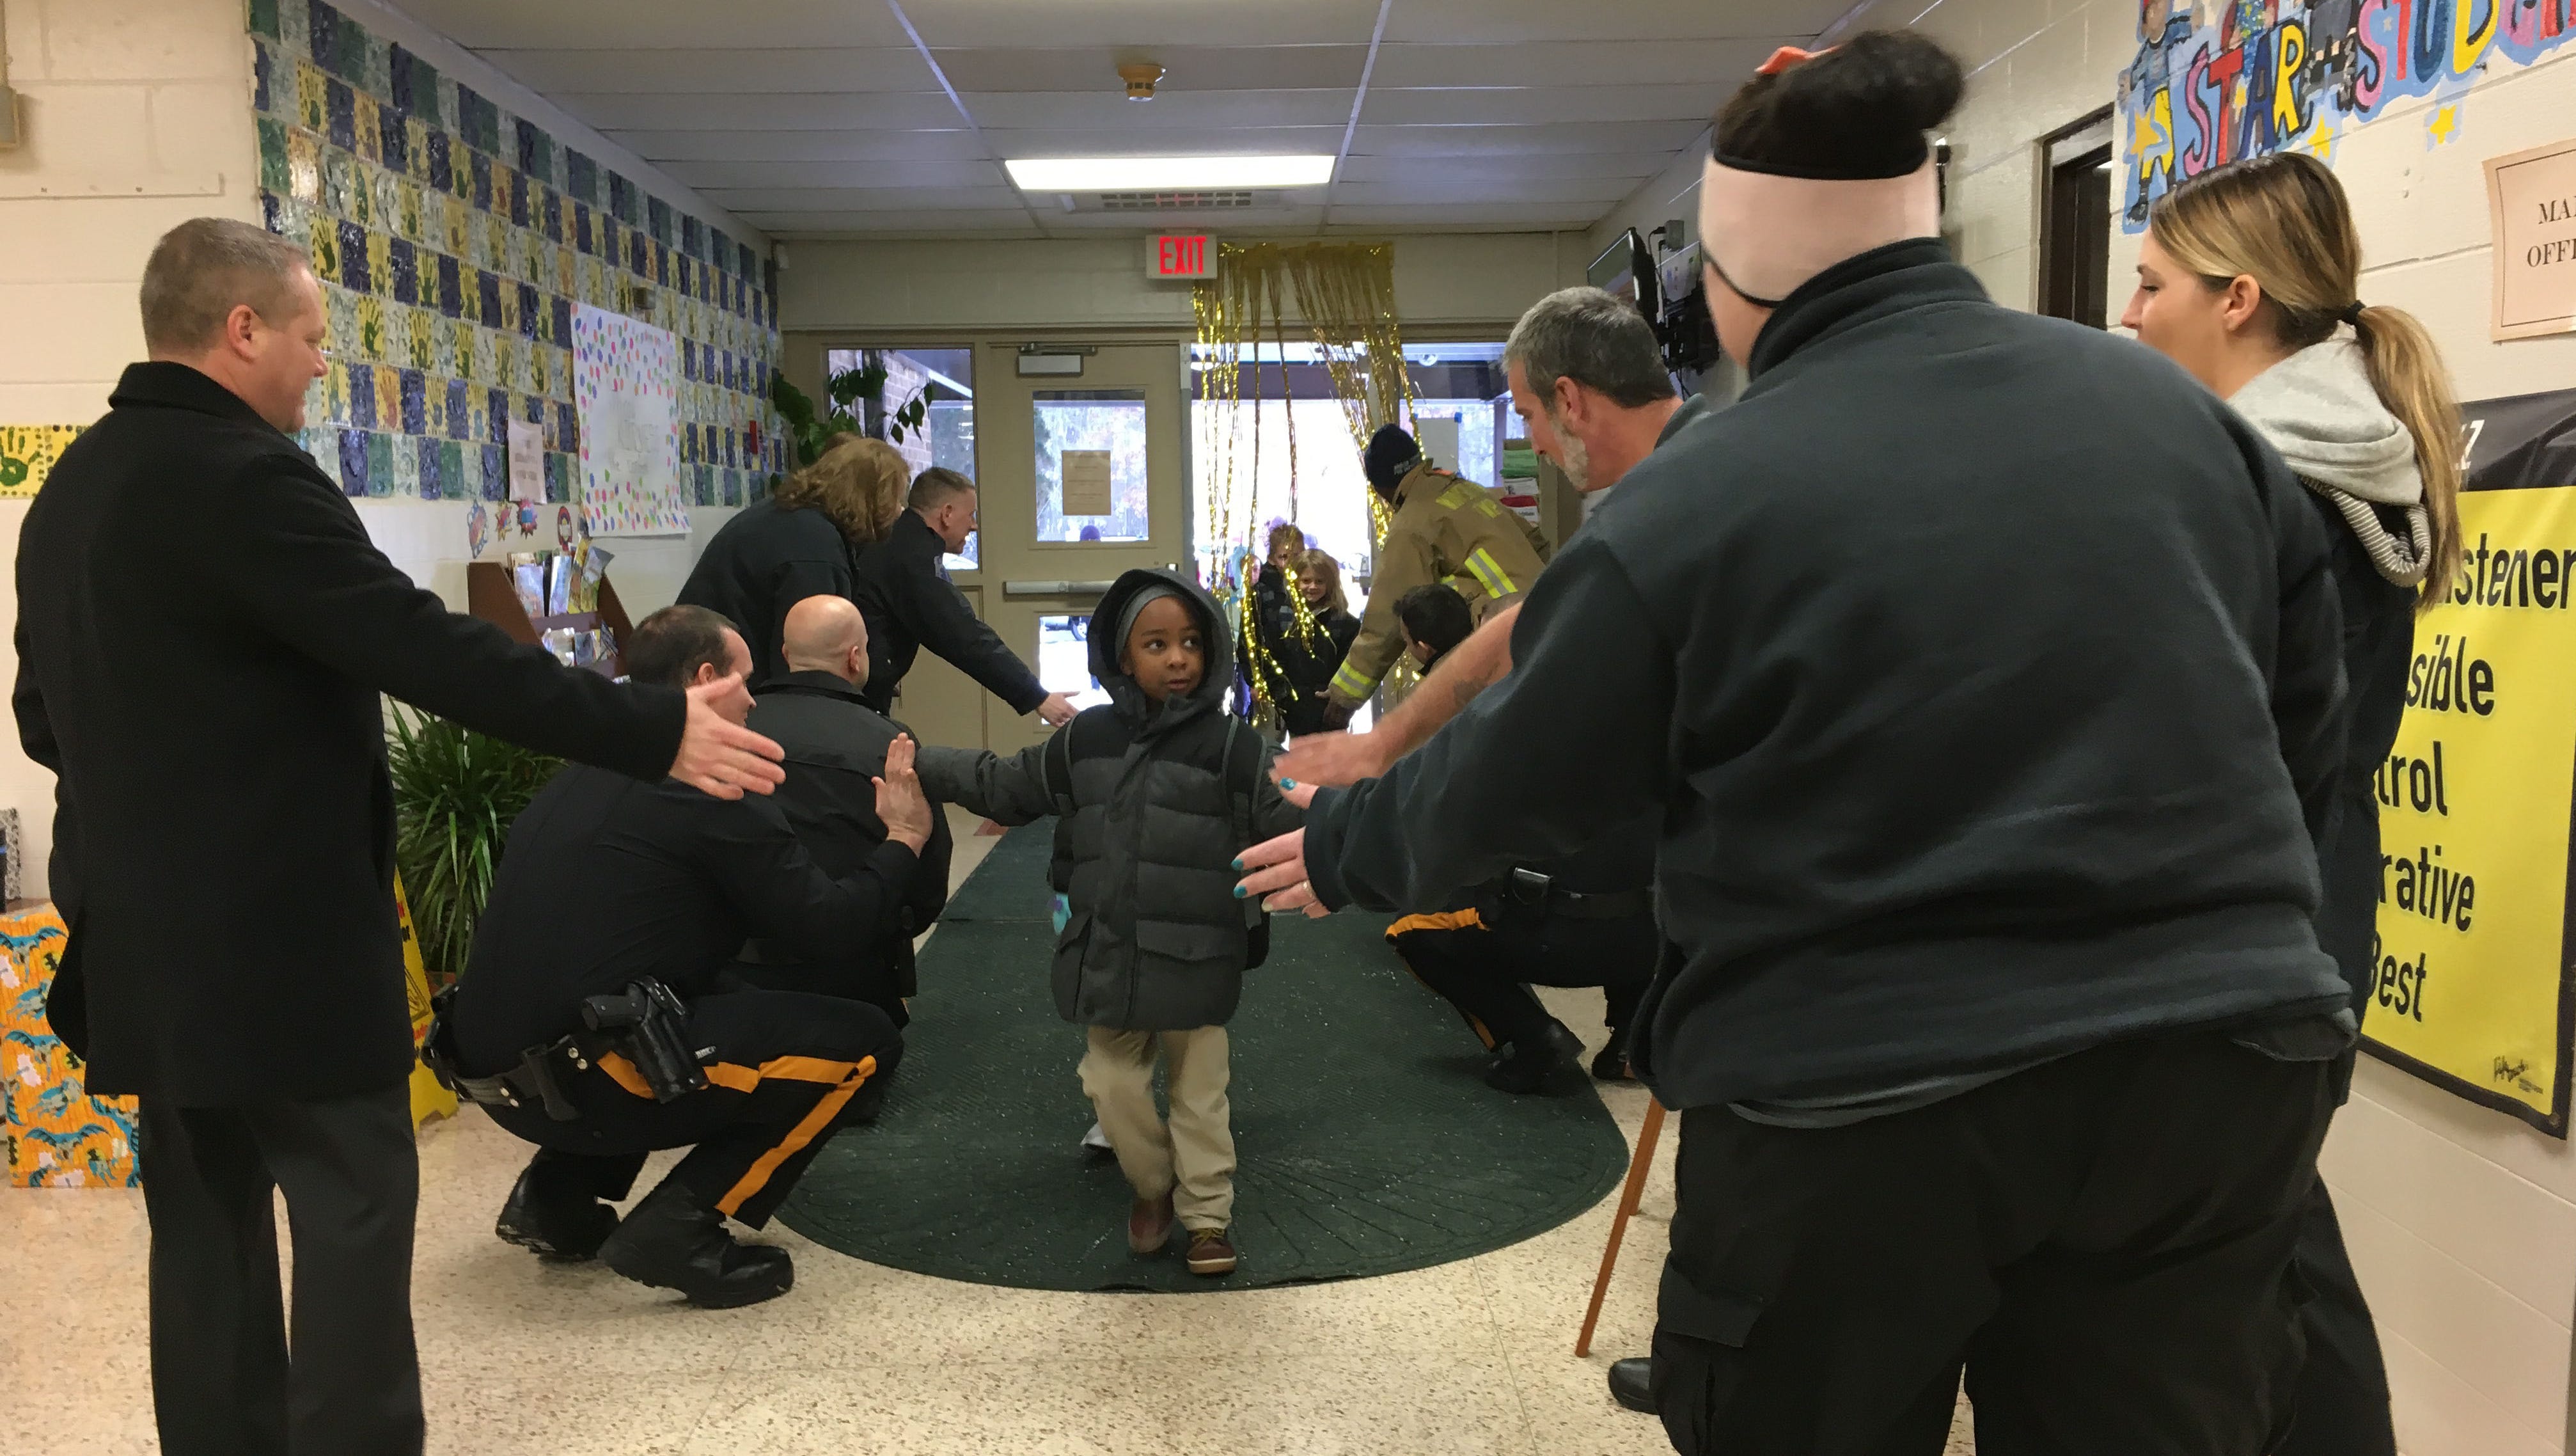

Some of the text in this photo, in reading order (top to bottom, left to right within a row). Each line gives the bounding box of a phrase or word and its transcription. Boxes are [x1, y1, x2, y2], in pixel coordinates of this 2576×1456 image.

[2183, 17, 2306, 177] STAR
[2538, 196, 2576, 224] MA
[1159, 236, 1207, 274] EXIT
[2446, 533, 2576, 609] stener
